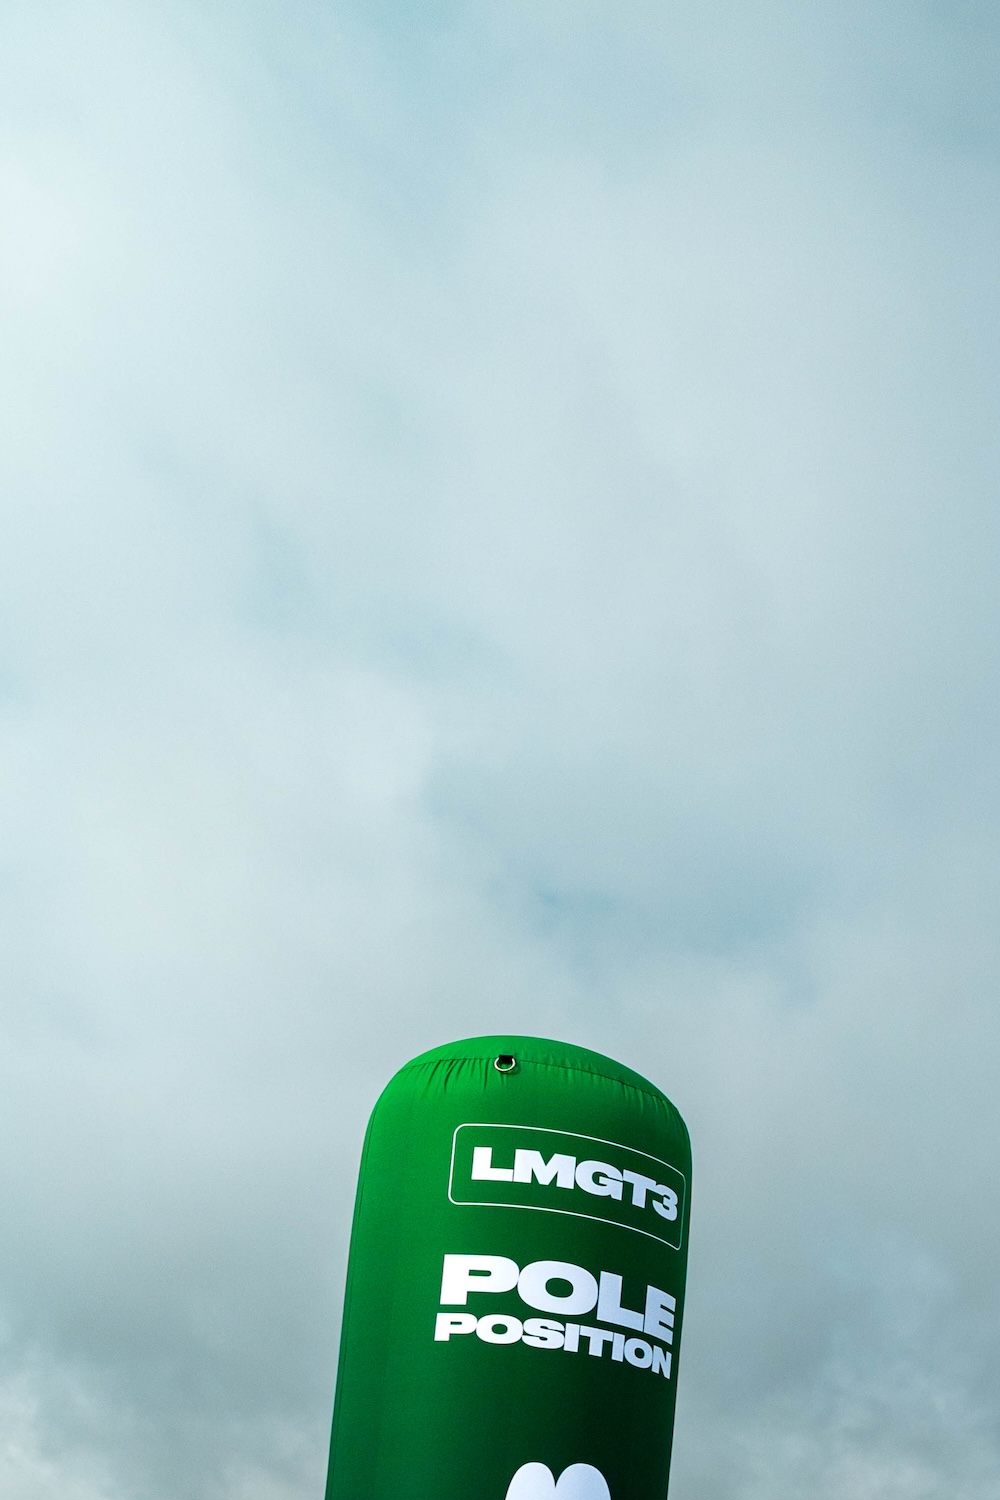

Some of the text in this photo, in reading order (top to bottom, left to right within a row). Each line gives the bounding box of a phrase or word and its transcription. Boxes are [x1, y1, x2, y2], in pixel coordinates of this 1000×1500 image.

[471, 1146, 679, 1223] LMGT3
[439, 1254, 677, 1347] POLE
[434, 1312, 673, 1380] POSITION
